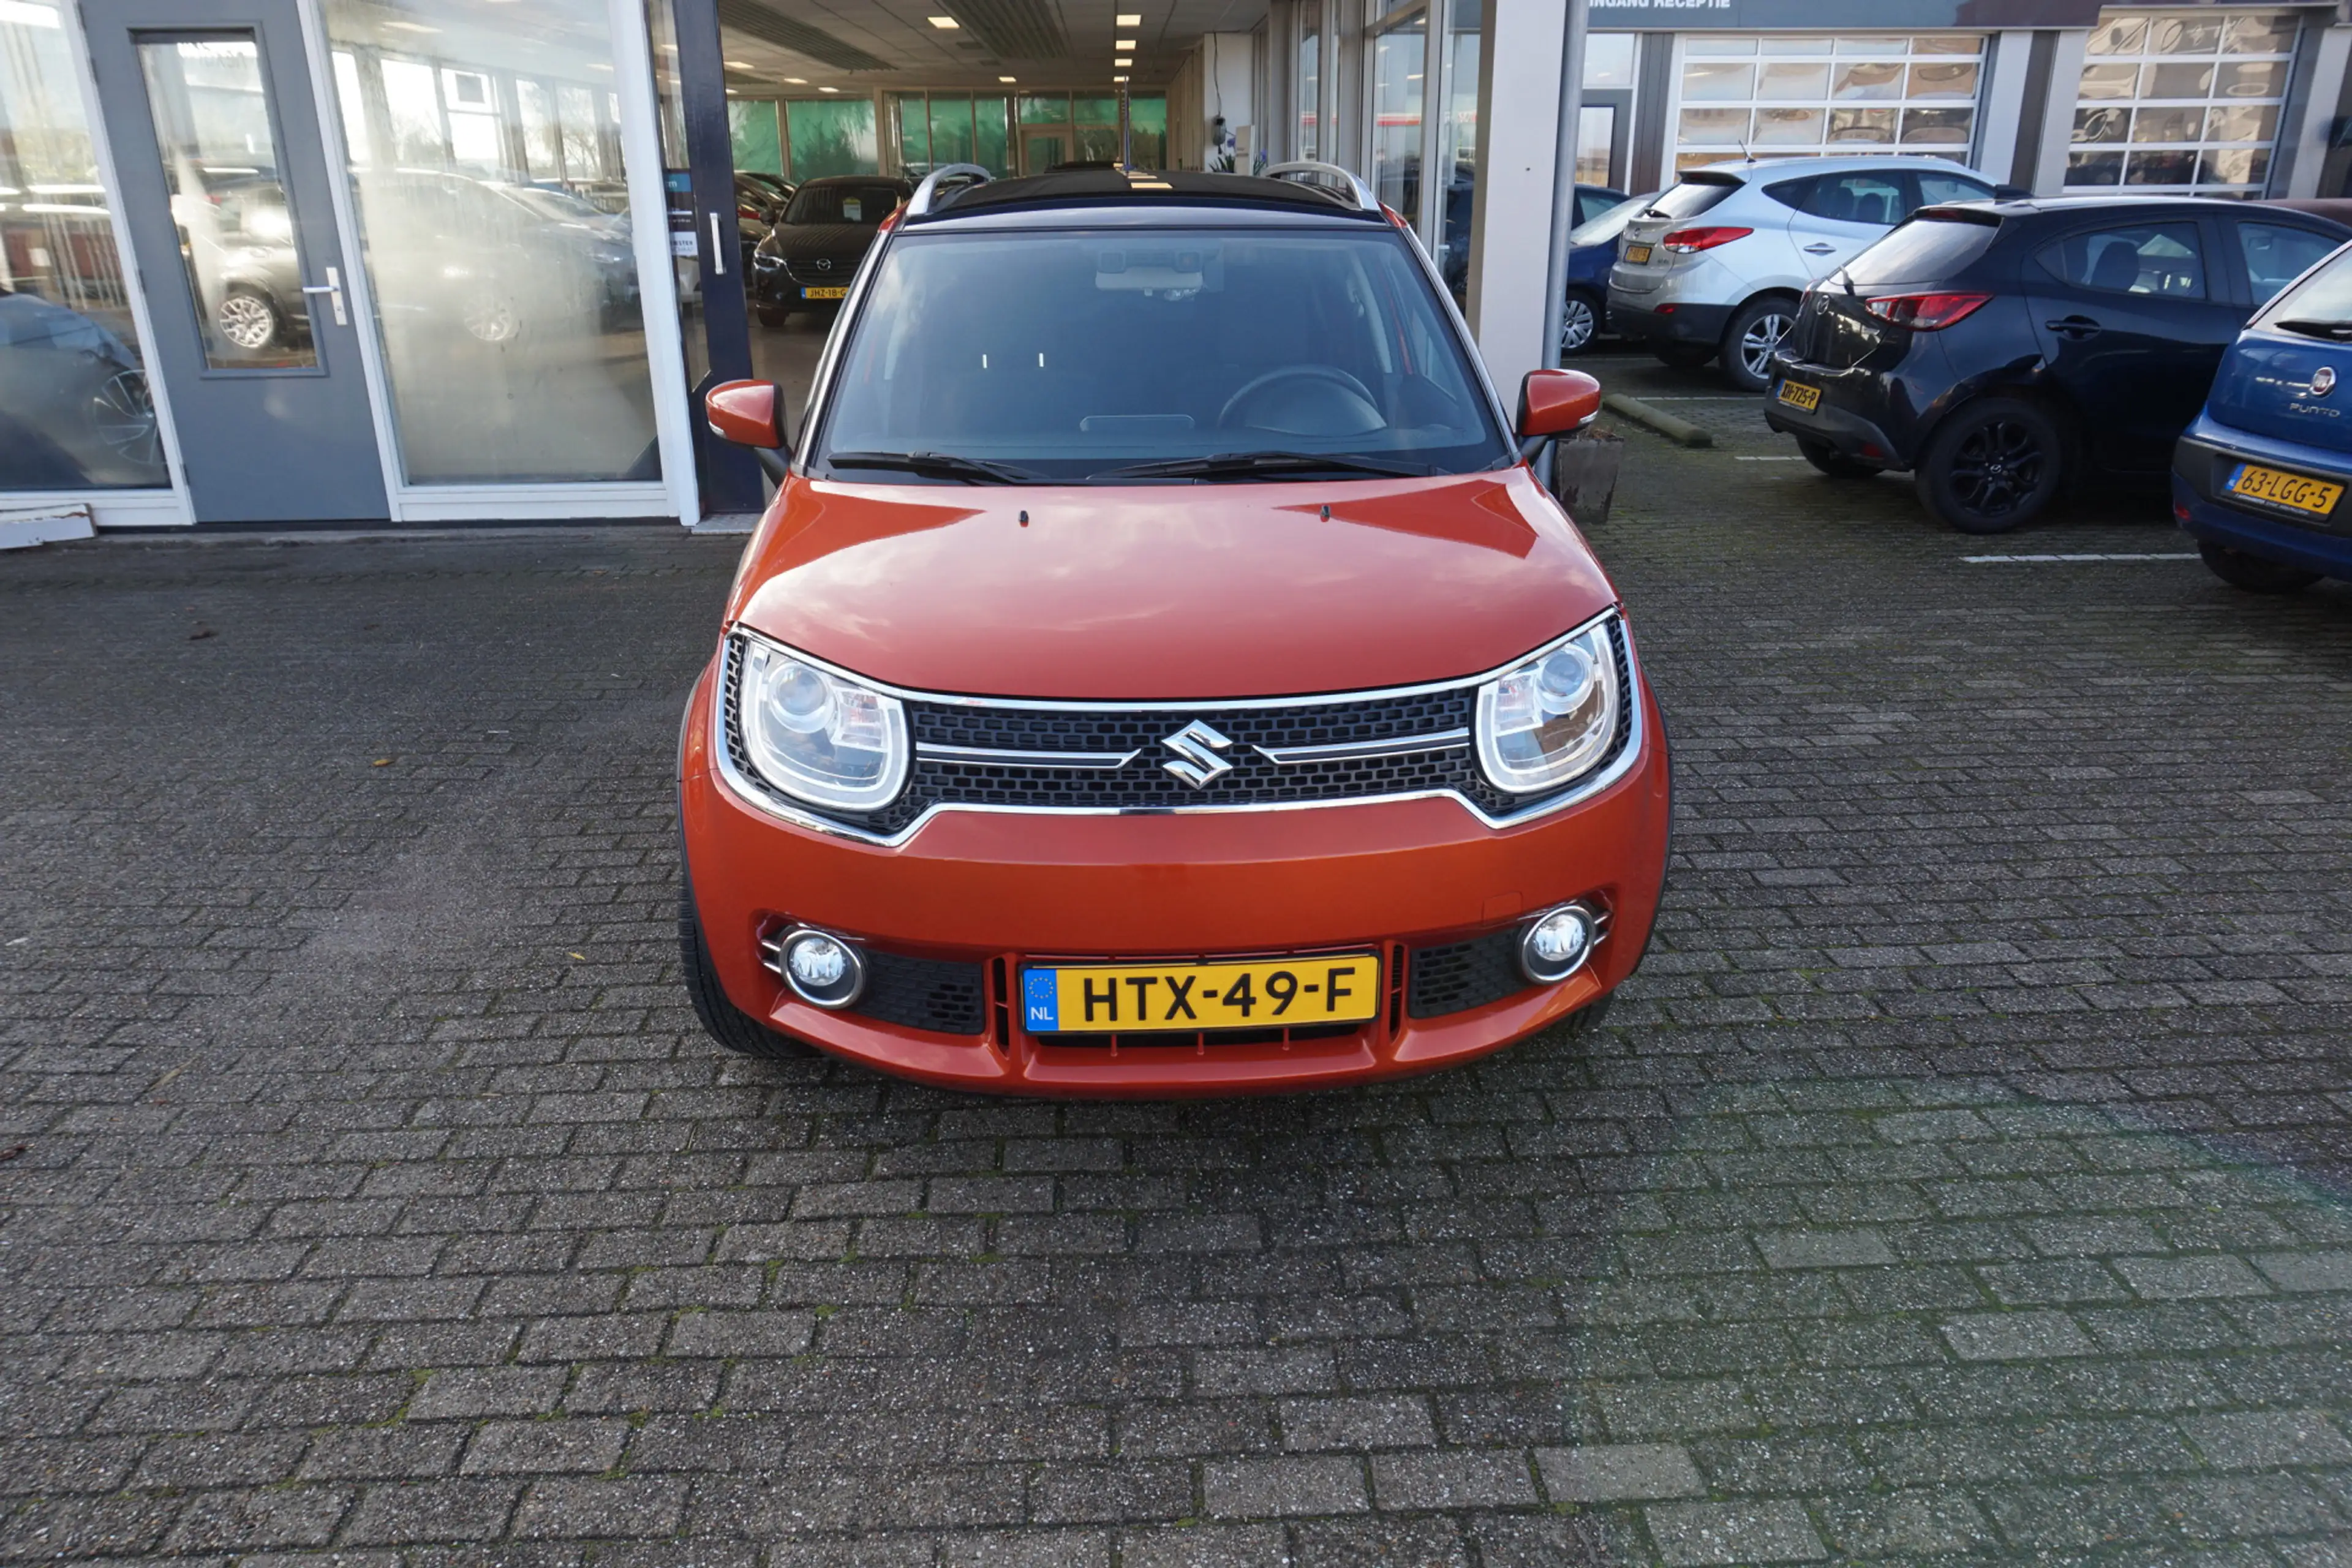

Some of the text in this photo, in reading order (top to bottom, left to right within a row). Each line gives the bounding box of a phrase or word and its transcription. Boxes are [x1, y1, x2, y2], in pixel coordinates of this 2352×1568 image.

[2241, 470, 2333, 509] 63-LGG-5
[1030, 1006, 1054, 1020] NL
[1084, 967, 1355, 1022] HTX-49-F
